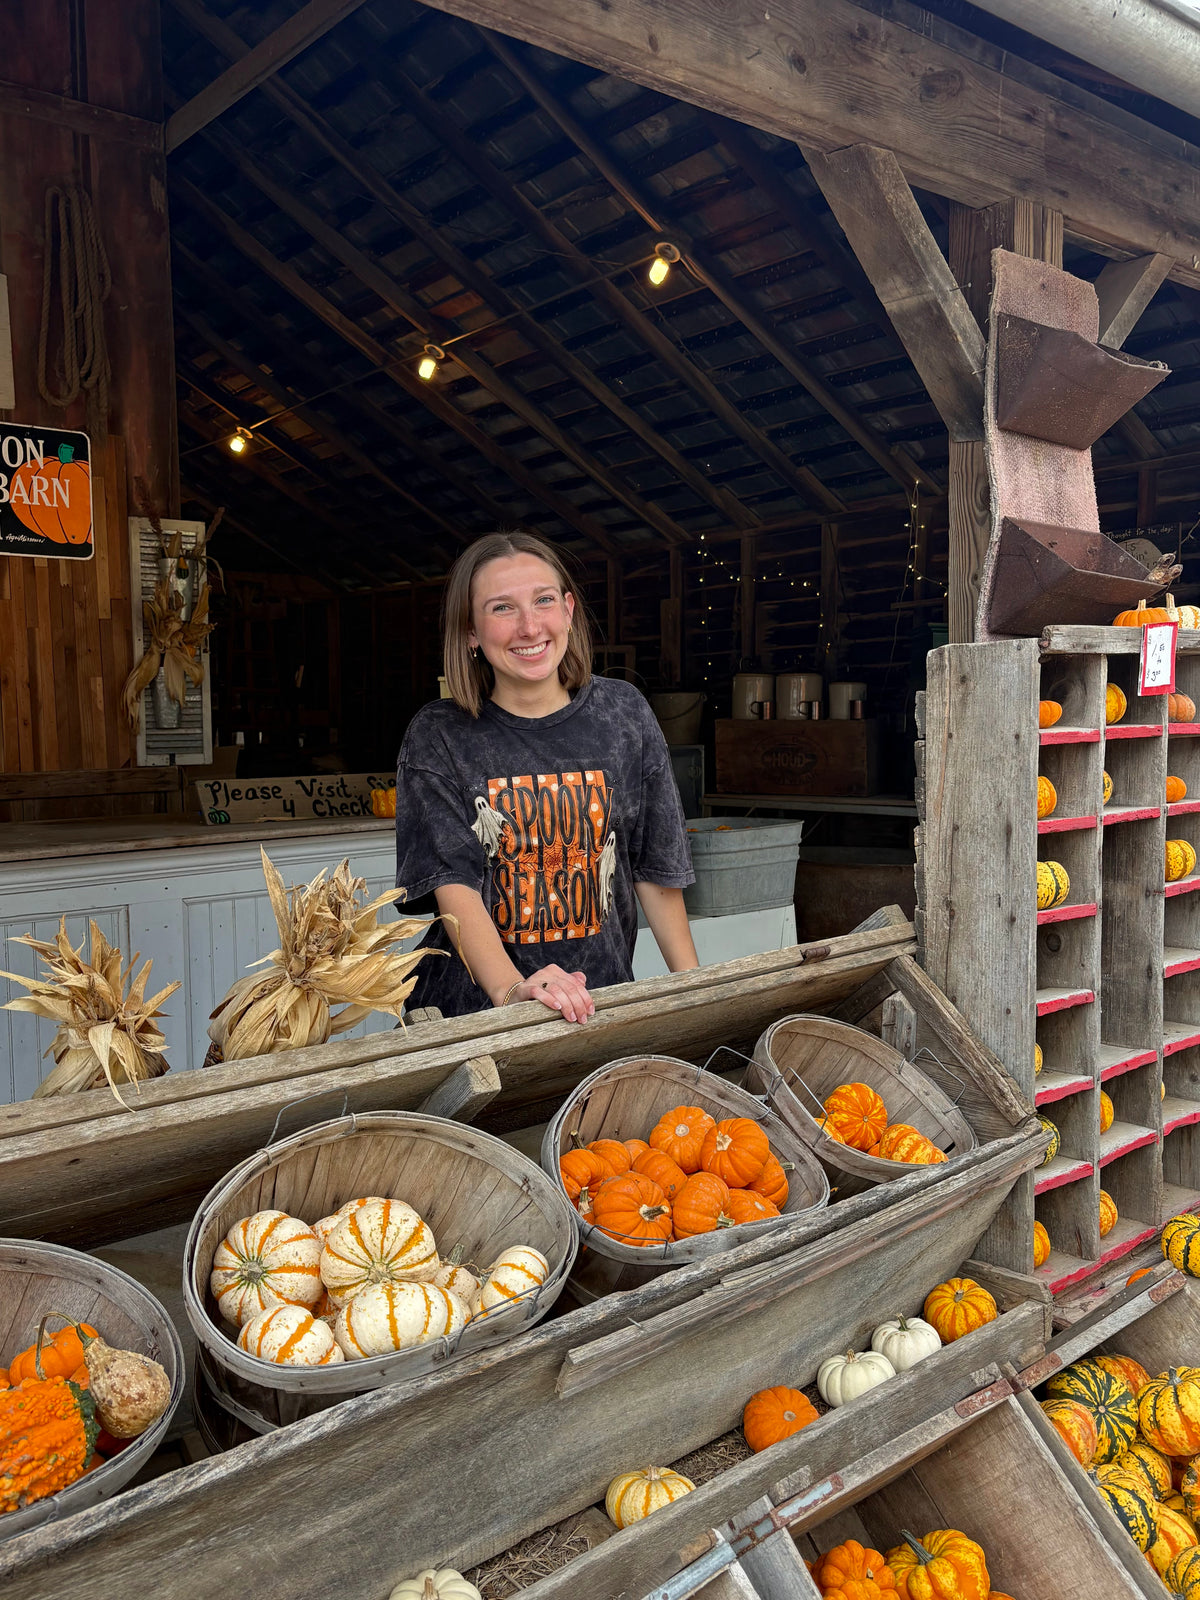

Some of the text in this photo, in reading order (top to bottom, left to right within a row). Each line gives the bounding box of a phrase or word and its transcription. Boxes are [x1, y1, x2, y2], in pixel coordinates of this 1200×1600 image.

[0, 435, 45, 470] ON
[203, 780, 283, 808] Please
[295, 776, 351, 799] Visit
[282, 799, 296, 818] 4
[495, 784, 614, 862] SPOOKY
[492, 862, 603, 933] SEASON
